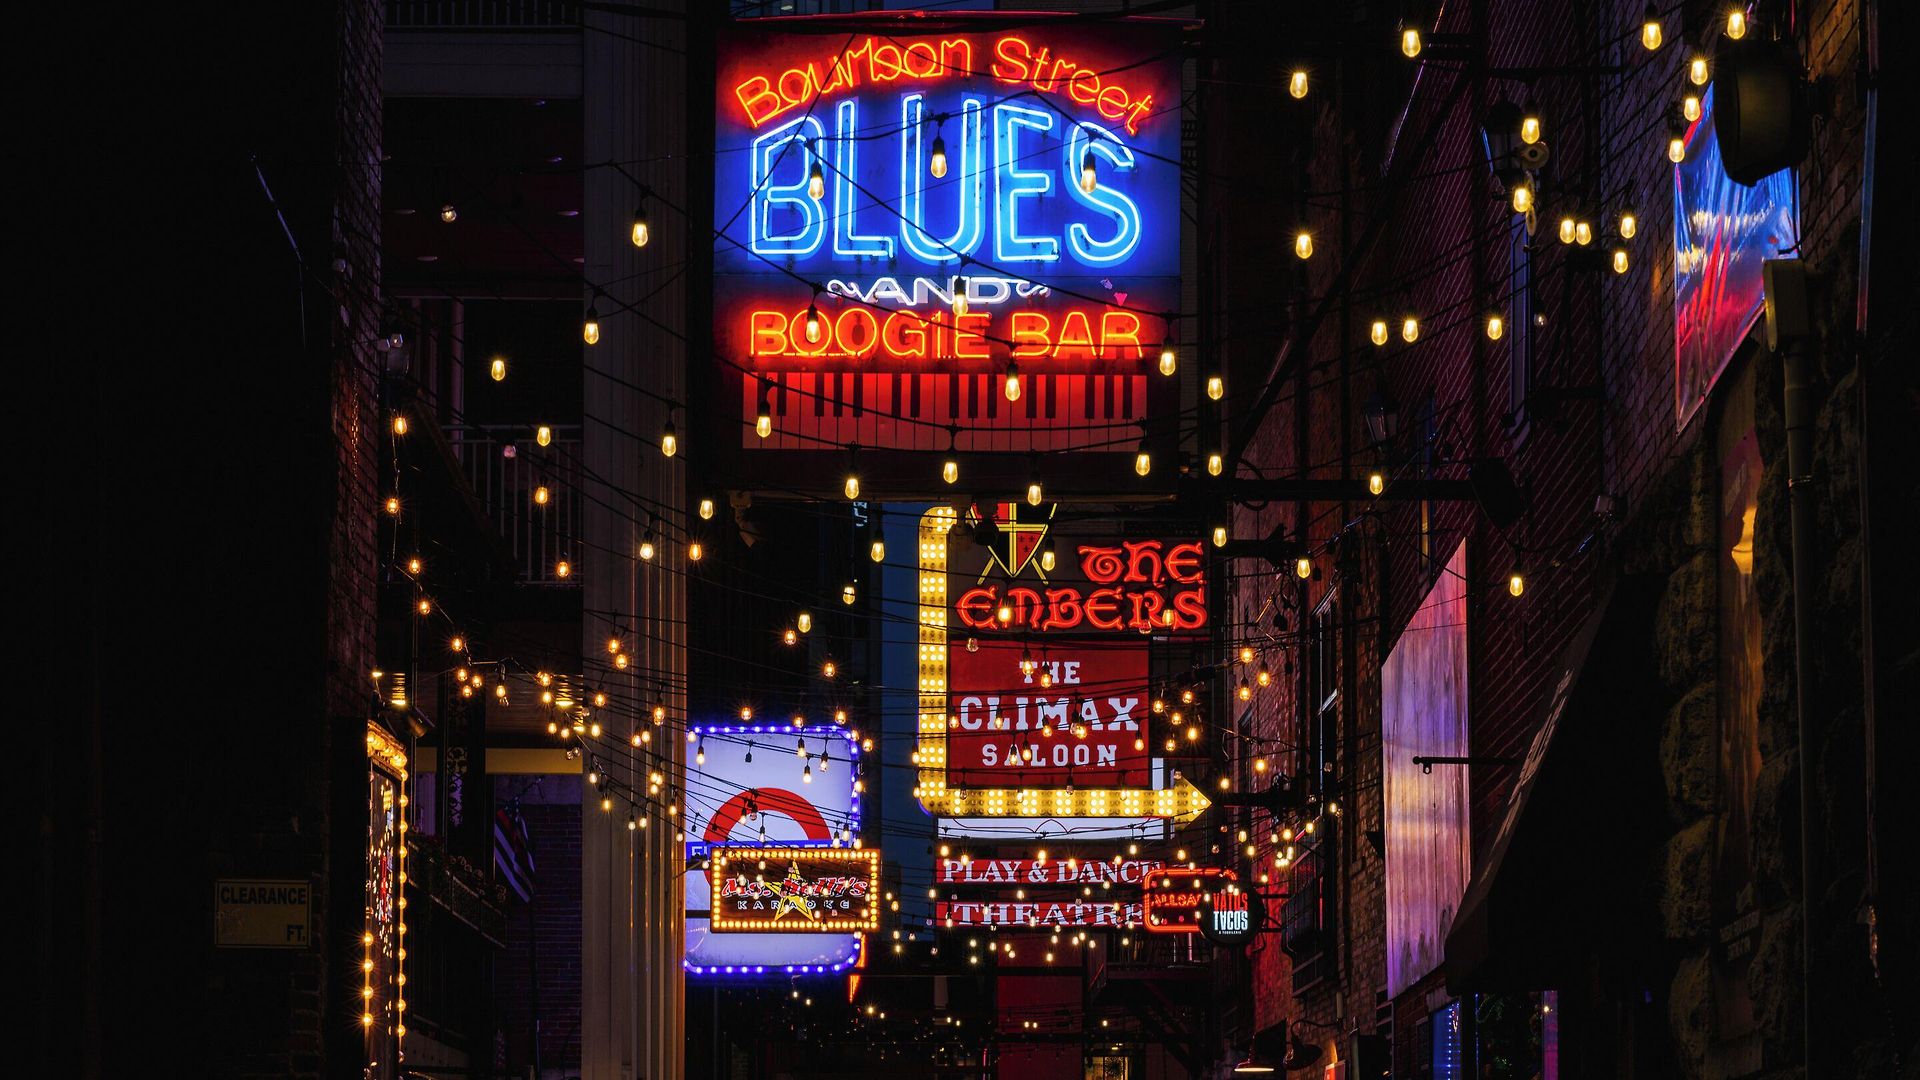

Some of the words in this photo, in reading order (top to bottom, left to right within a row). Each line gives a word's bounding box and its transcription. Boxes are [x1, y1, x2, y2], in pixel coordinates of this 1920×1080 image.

[735, 37, 972, 128] Bourbon
[991, 37, 1153, 136] Street
[748, 92, 1143, 263] BLUES
[860, 276, 1012, 306] AND
[750, 308, 990, 359] BOOGIE
[1011, 311, 1143, 359] BAR
[1077, 540, 1207, 588] THE
[956, 585, 1208, 631] EMBERS
[1020, 661, 1081, 684] THE
[959, 697, 1139, 731] CLIMAX
[982, 744, 1117, 767] SALOON
[943, 861, 1022, 882] PLAY
[1028, 861, 1048, 882] &
[220, 887, 306, 905] CLEARANCE
[738, 900, 850, 910] KARAOKE
[1213, 892, 1248, 912] VATOS
[953, 903, 1143, 927] THEATRE
[1213, 911, 1248, 931] TACOS
[287, 924, 306, 942] FT.
